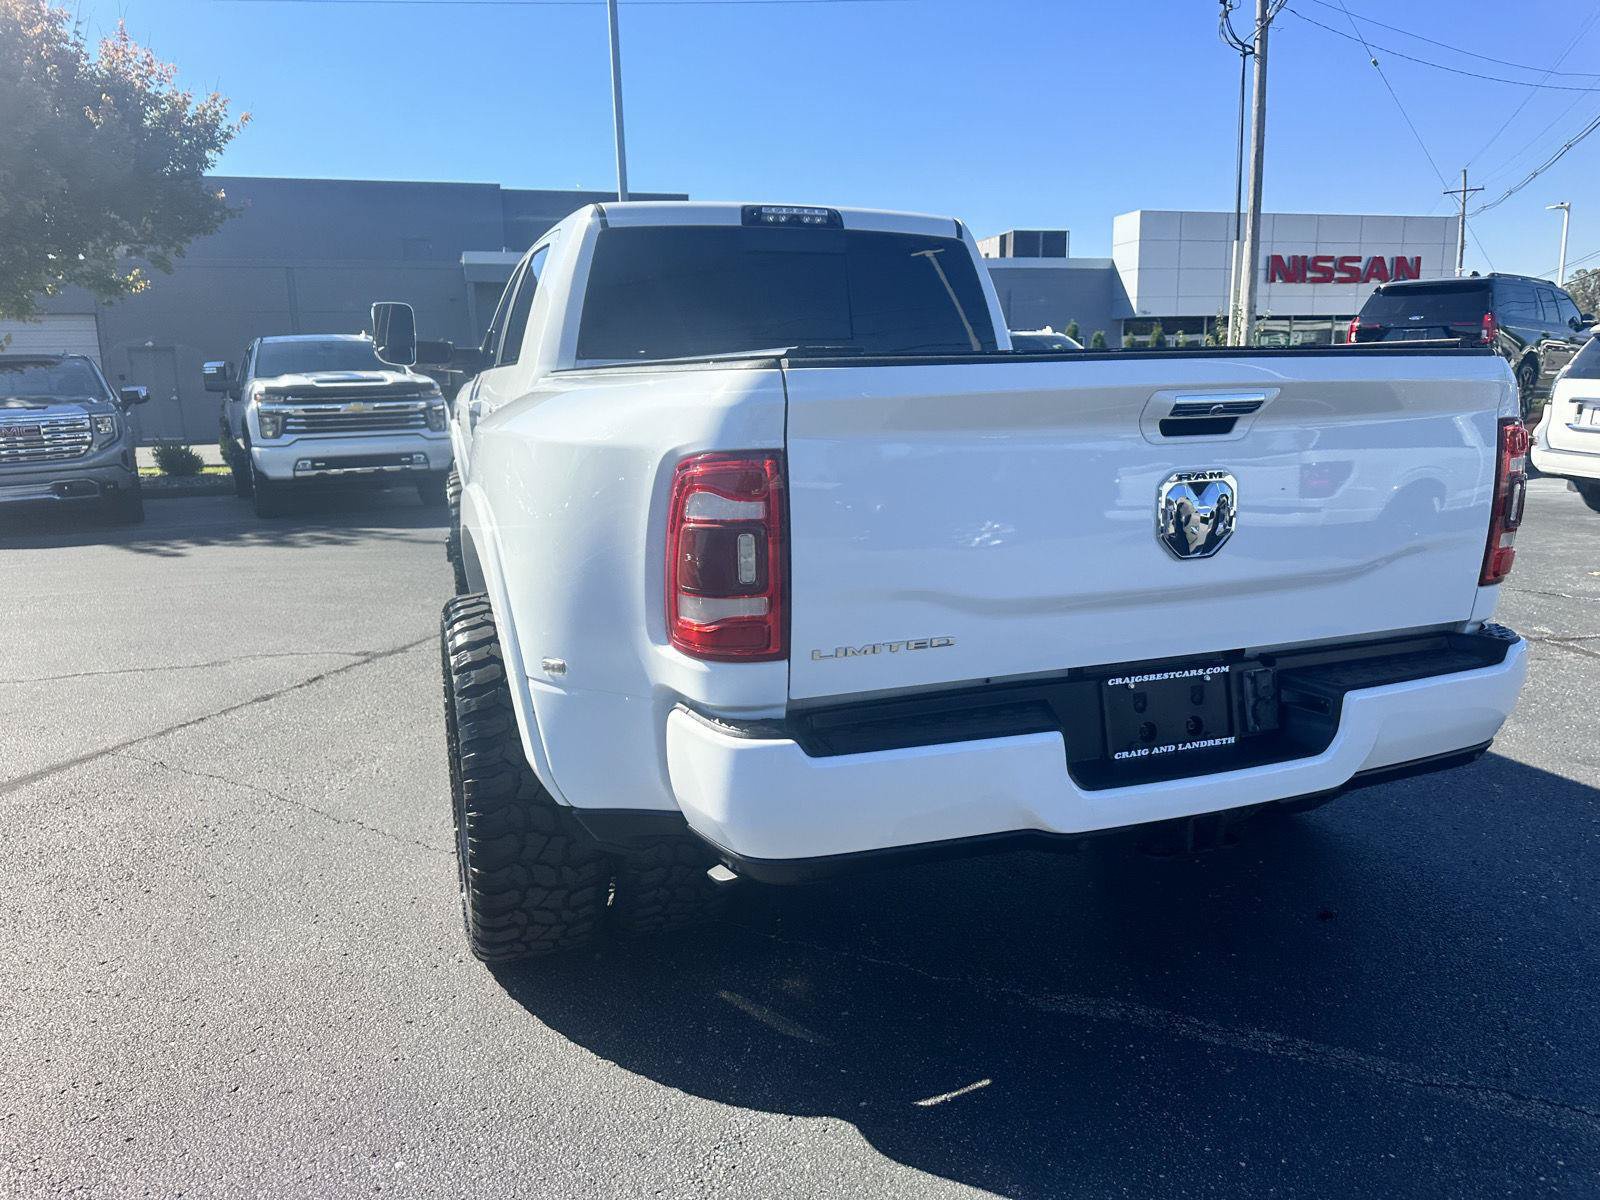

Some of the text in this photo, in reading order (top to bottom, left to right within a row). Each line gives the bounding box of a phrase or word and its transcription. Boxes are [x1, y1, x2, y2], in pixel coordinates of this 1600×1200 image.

[1268, 254, 1422, 284] NISSAN
[1177, 471, 1224, 481] RAM
[811, 636, 957, 661] LIMITED
[1107, 666, 1230, 685] CRAIGSBESTCARS.COM
[1114, 736, 1236, 760] CRAIG AND LANDRETH
